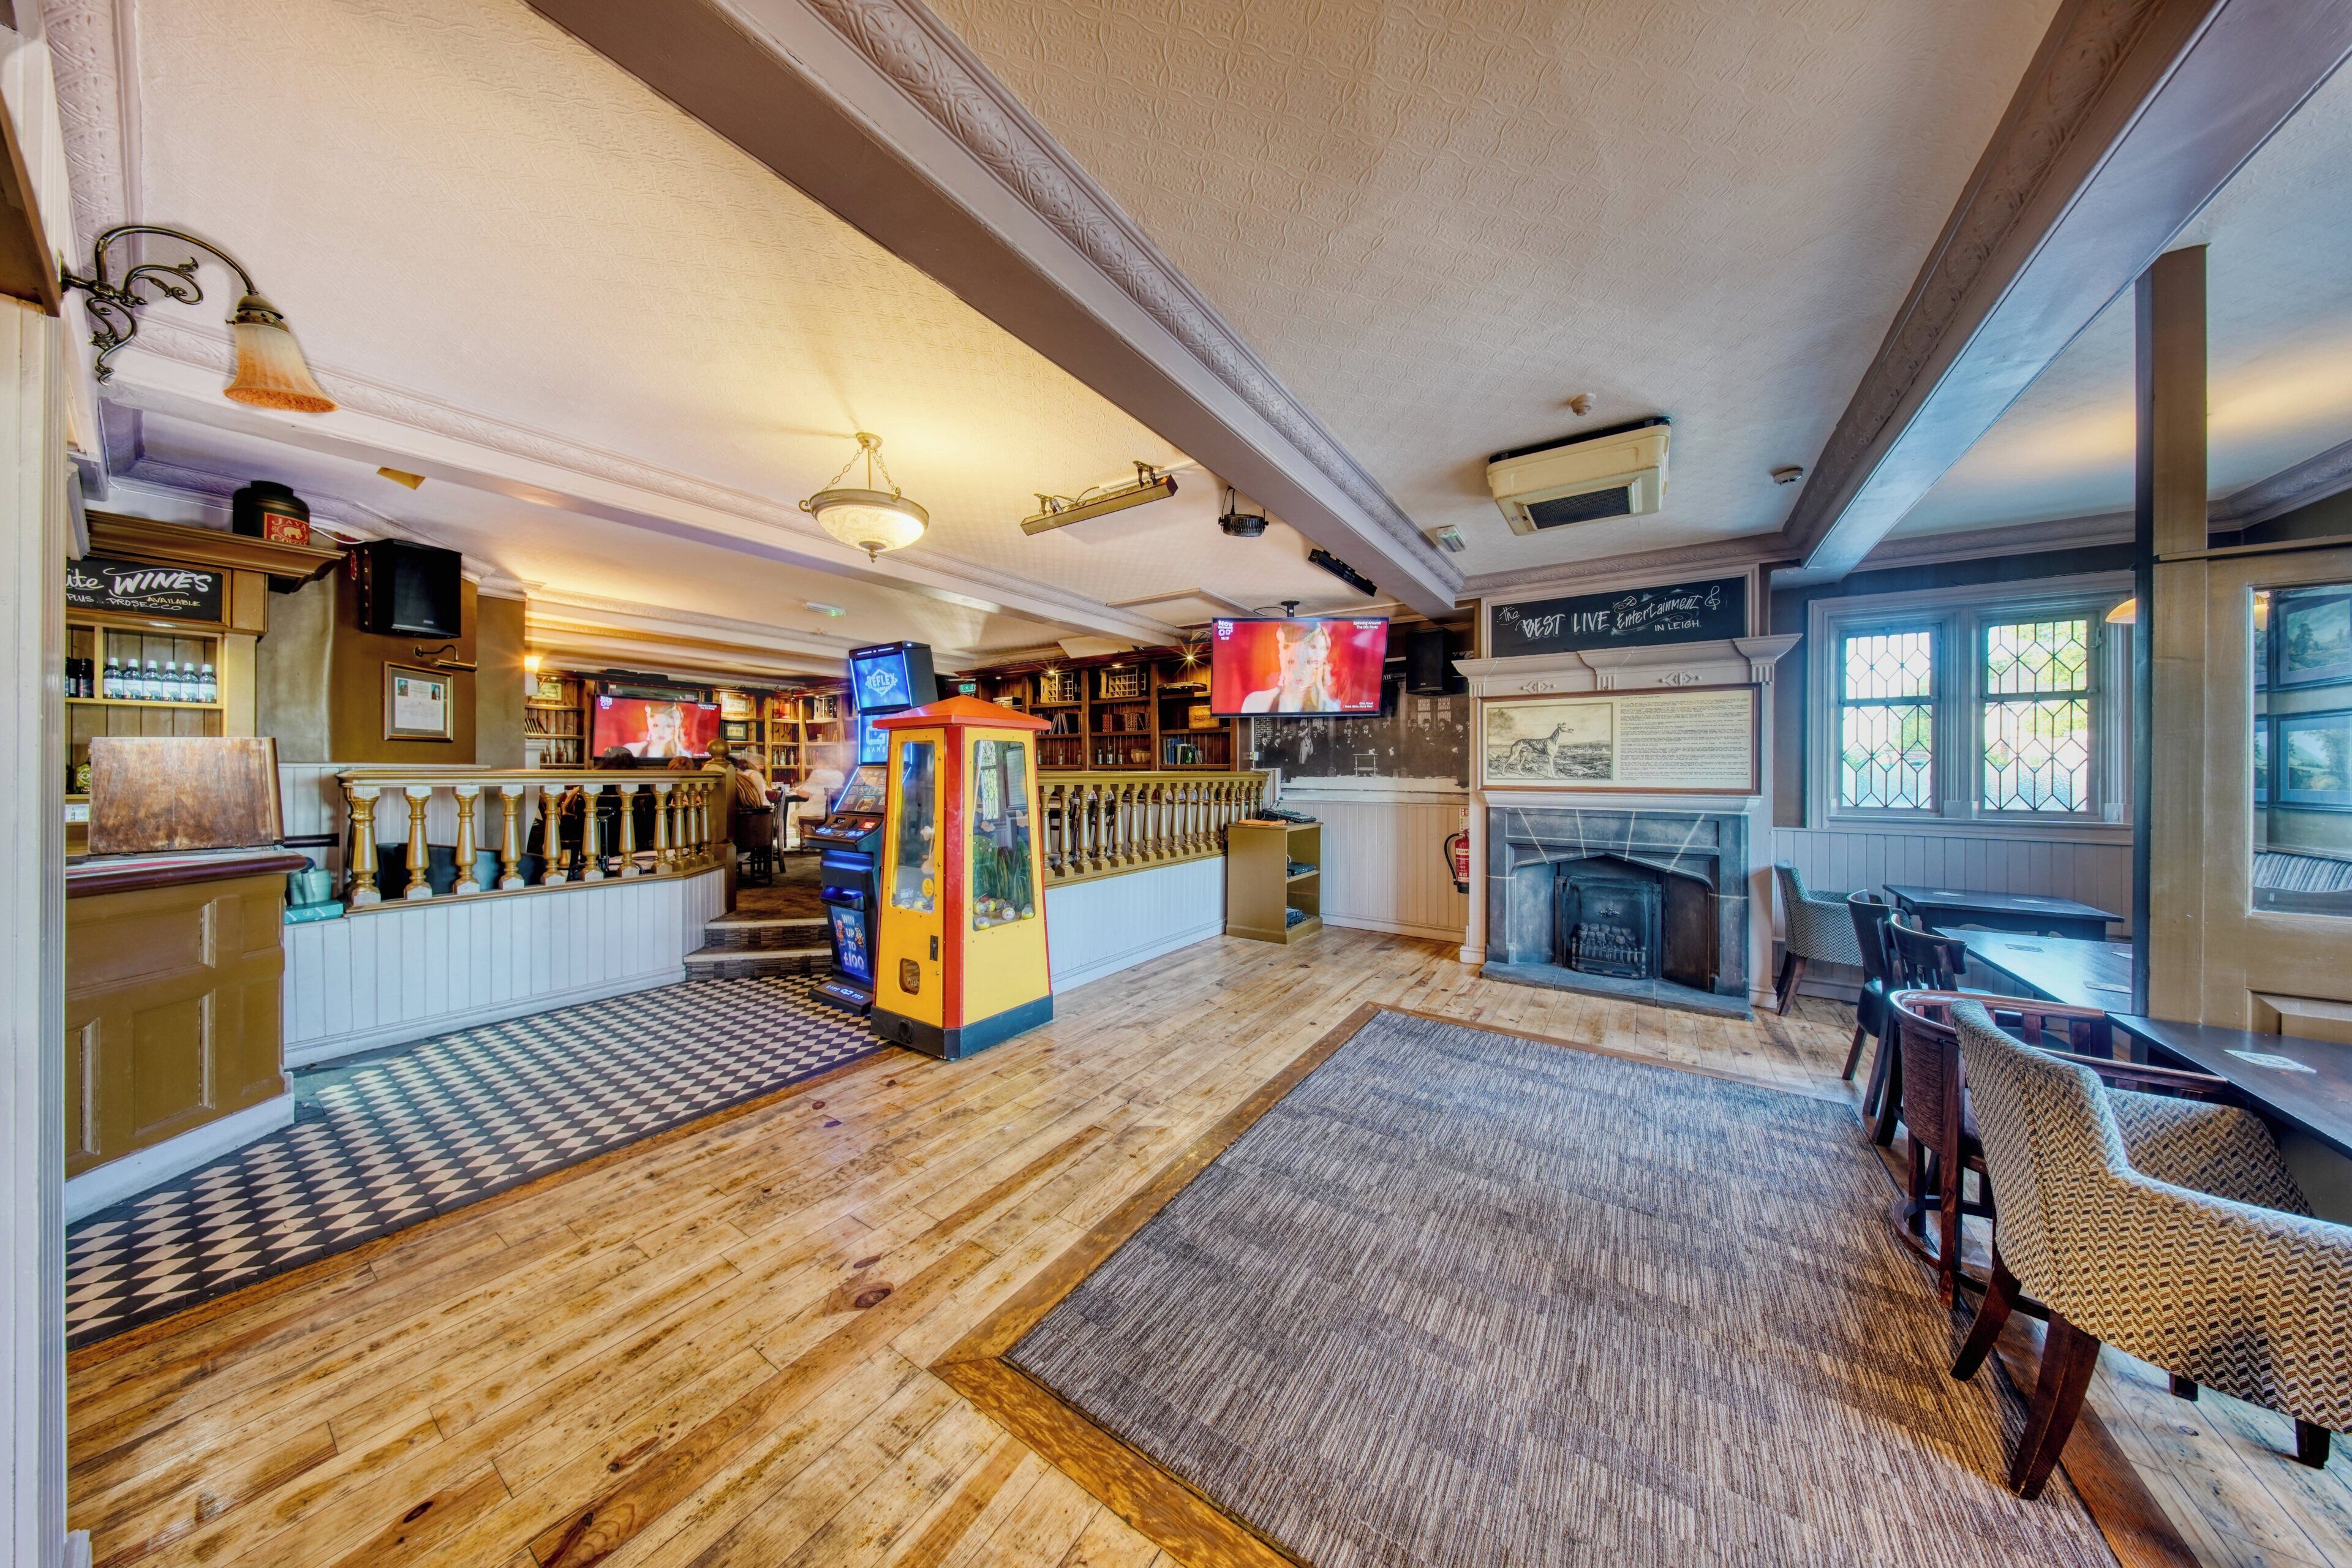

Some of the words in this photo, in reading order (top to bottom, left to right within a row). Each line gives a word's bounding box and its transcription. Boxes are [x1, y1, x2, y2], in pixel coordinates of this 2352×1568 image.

[271, 518, 307, 532] JAVA
[66, 568, 104, 589] ite
[114, 572, 212, 595] WINES
[106, 598, 182, 611] PROSECCO
[146, 596, 201, 606] AVAILABLE
[1499, 606, 1520, 622] the
[1516, 614, 1566, 638] BEST
[1574, 611, 1610, 633] LIVE
[1616, 594, 1703, 630] Entertainment
[865, 673, 896, 690] REFLEX
[842, 914, 855, 925] WIN
[846, 928, 854, 938] UP
[847, 940, 856, 951] TO
[843, 952, 864, 970] £100
[907, 977, 920, 988] Push
